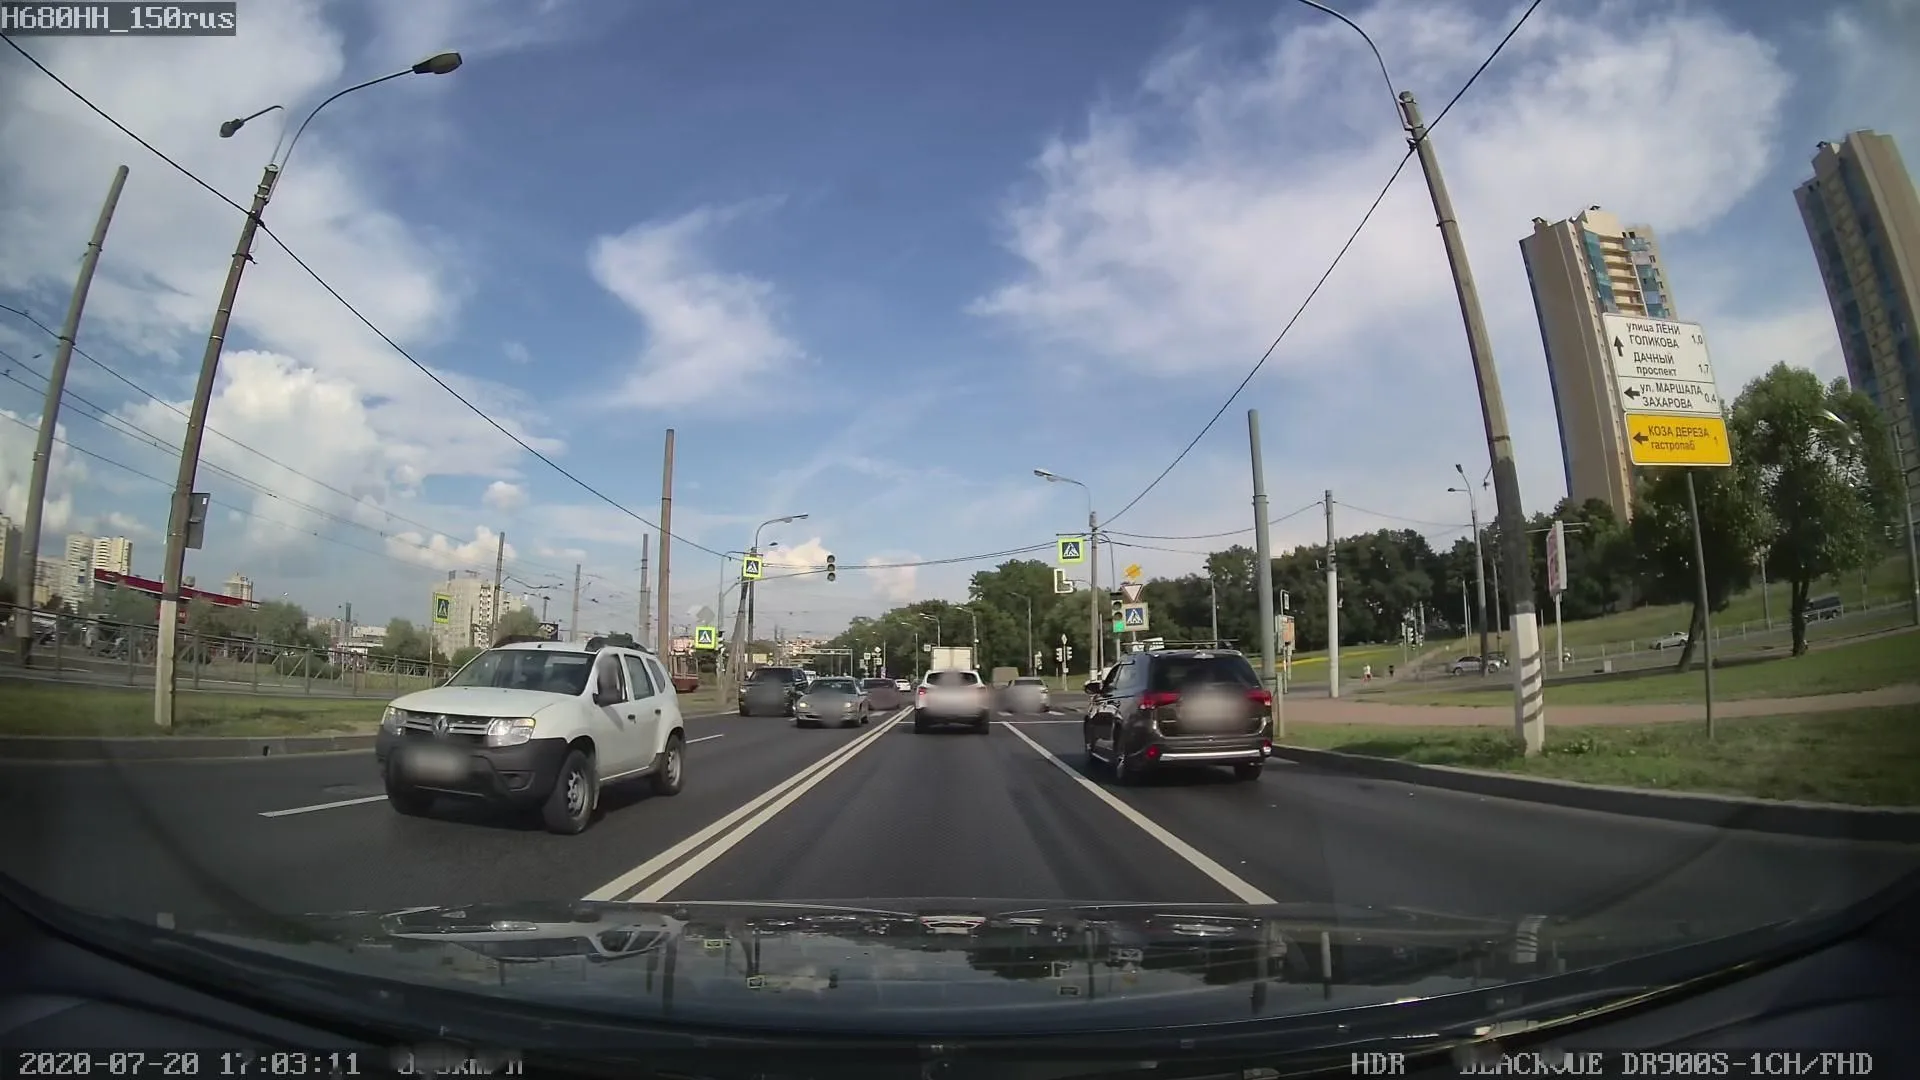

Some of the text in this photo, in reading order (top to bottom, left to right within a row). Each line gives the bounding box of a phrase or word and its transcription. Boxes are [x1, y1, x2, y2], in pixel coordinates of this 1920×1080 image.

[1626, 322, 1681, 335] улица ЛЕНИ
[1629, 334, 1680, 349] ГОЛИКОВА
[1634, 352, 1675, 364] ДАЧНЫЙ
[1636, 366, 1677, 377] проспект
[1640, 382, 1703, 395] ул. МАРШАЛА
[1642, 397, 1693, 409] ЗАХАРОВА
[1648, 425, 1710, 438] КОЗА ДЕРЕЗА
[1651, 440, 1696, 451] гастропаб
